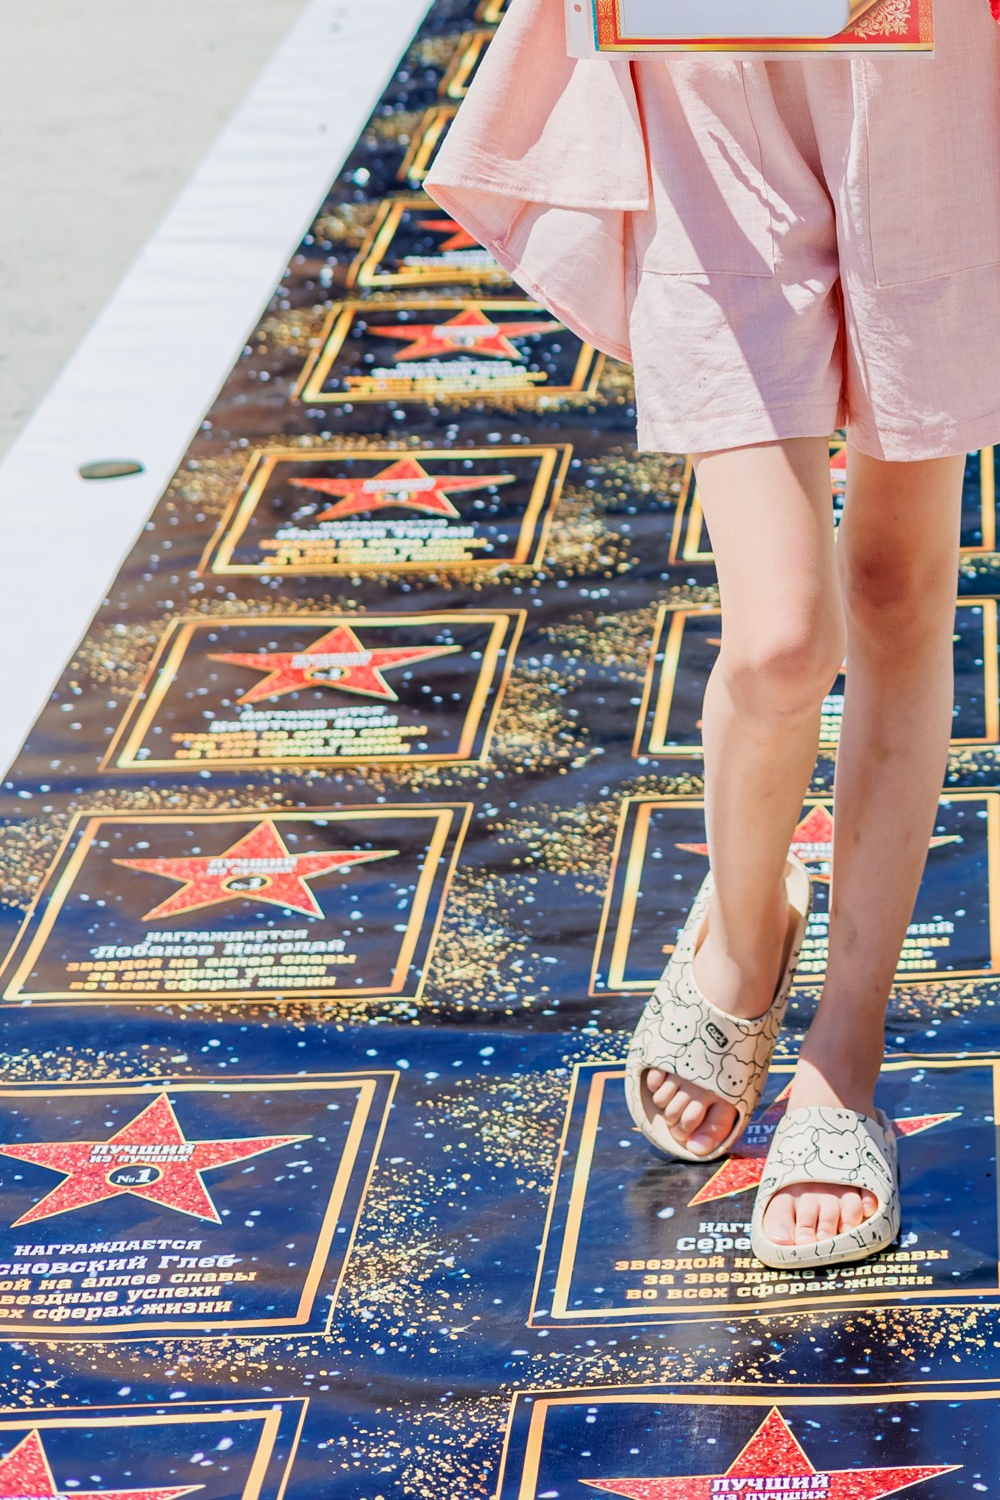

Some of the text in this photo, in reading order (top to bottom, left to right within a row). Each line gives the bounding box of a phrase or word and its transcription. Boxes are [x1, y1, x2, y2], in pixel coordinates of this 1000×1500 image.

[91, 1143, 196, 1155] ЛУЧШИЙ
[89, 1153, 190, 1164] из лучших
[116, 1168, 153, 1184] №1
[14, 1238, 203, 1257] НАГРАЖДАЕТСЯ
[157, 1254, 236, 1269] Глеб
[614, 1255, 726, 1272] звездой
[734, 1257, 765, 1269] на
[39, 1278, 72, 1291] на
[81, 1273, 161, 1289] аллее
[169, 1271, 258, 1284] славы
[643, 1263, 919, 1285] за звездные успехи
[0, 1285, 222, 1306] вездные успехи
[626, 1274, 934, 1300] во всех сферах жизни
[32, 1302, 135, 1322] сферах
[140, 1300, 233, 1316] жизни
[711, 1474, 829, 1492] ЛУЧШИЙ
